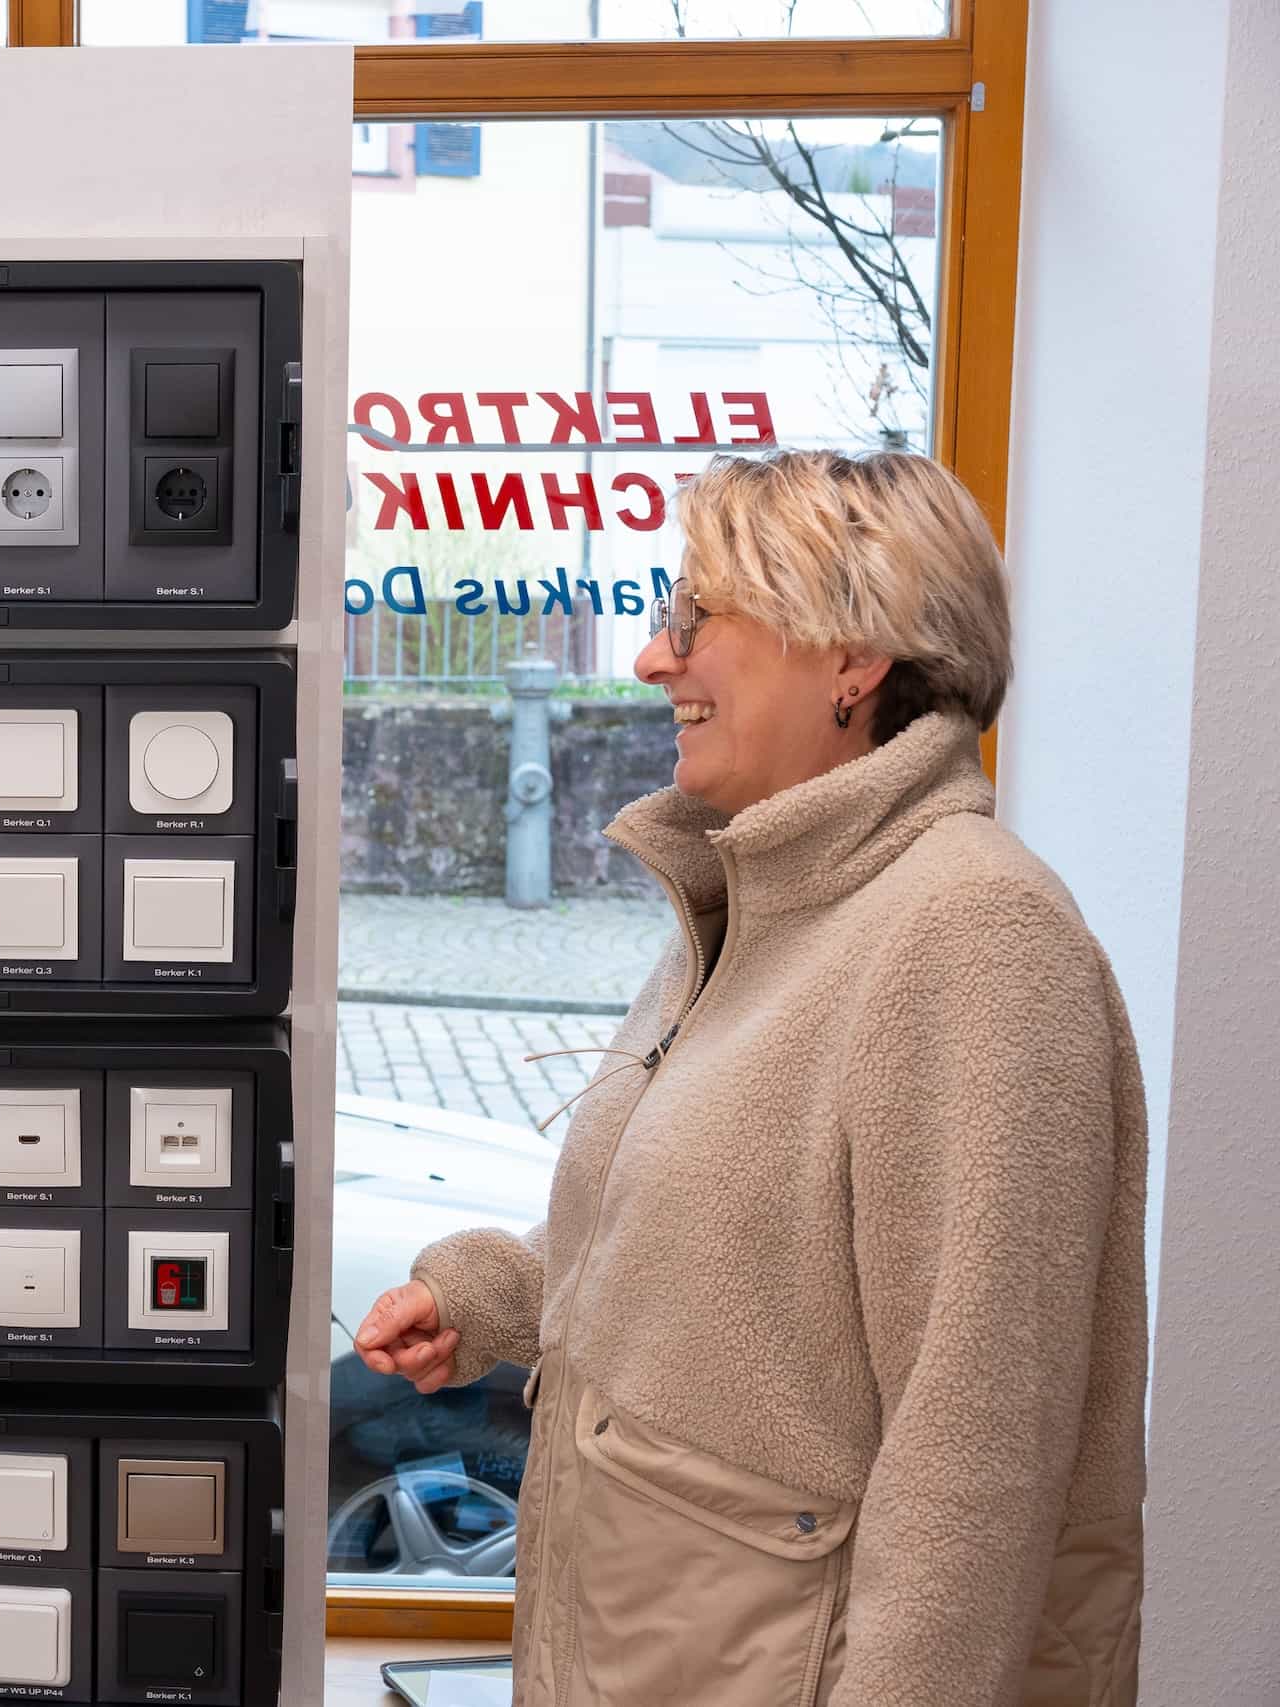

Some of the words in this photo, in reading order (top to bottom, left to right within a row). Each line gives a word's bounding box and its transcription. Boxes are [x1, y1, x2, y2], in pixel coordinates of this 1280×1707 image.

[156, 587, 187, 595] Berker
[190, 587, 203, 595] S.1
[36, 819, 50, 827] Q.1
[2, 966, 33, 974] Berker
[35, 967, 52, 975] Q.3
[39, 1193, 52, 1201] S.1
[156, 1194, 186, 1202] Berker
[7, 1333, 37, 1341] Berker
[147, 1556, 177, 1564] Berker
